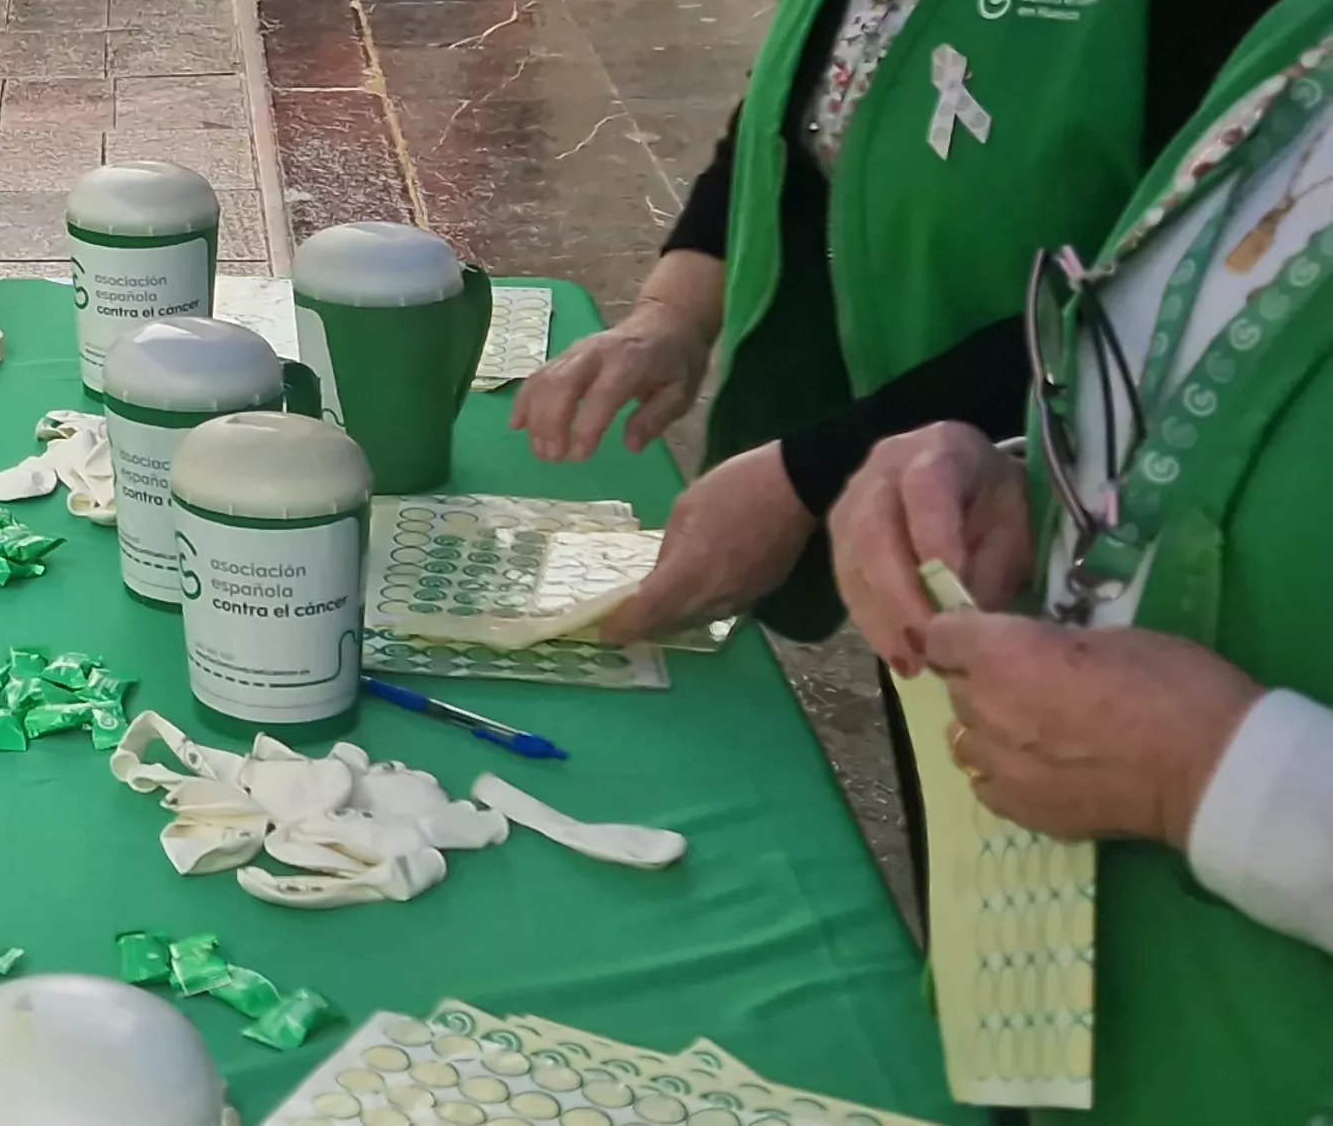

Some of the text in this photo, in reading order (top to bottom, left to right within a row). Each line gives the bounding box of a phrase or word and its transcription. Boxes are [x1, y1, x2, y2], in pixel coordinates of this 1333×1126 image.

[94, 274, 167, 287] asociación
[95, 290, 157, 302] española
[97, 299, 200, 318] contra el cáncer
[120, 450, 171, 471] asociac
[121, 467, 169, 489] españo
[122, 485, 163, 506] contra
[210, 558, 306, 578] asociación
[211, 578, 293, 598] española
[212, 595, 348, 618] contra el cáncer
